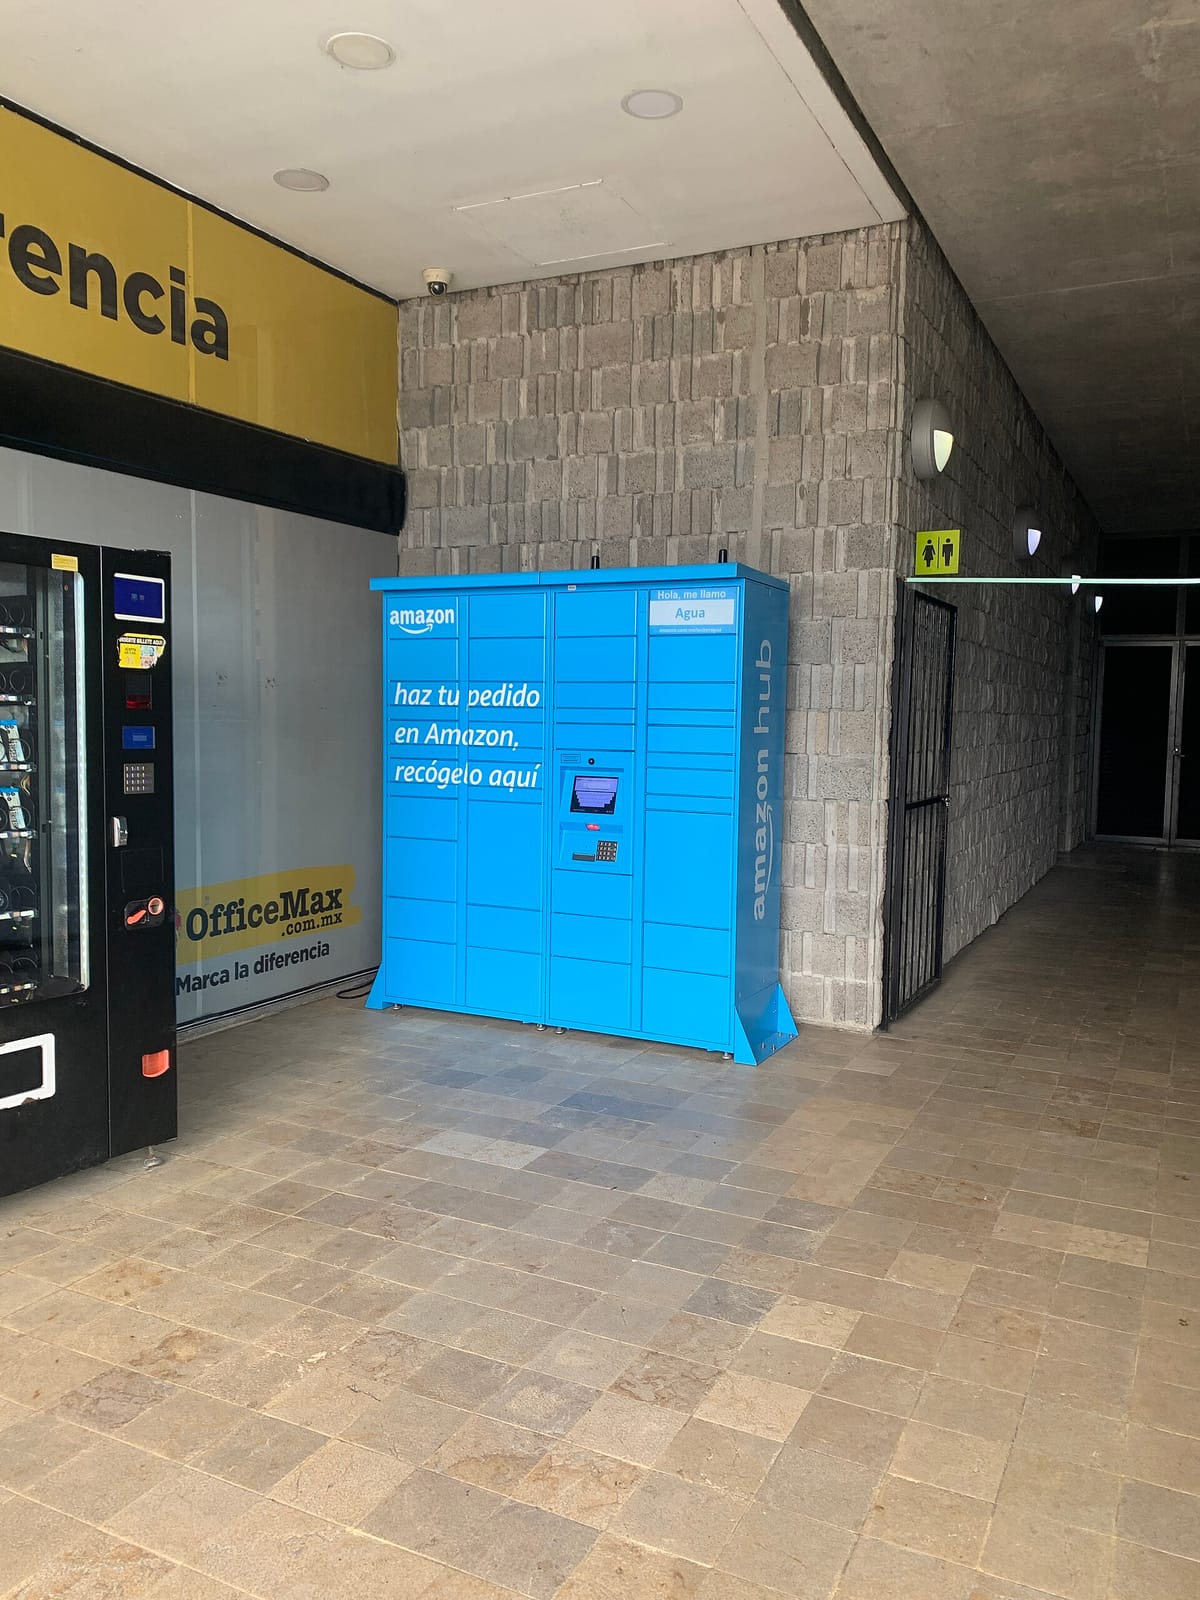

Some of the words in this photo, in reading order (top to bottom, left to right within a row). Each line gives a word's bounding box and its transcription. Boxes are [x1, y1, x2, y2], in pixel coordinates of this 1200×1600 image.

[0, 212, 229, 361] encia
[657, 590, 681, 600] Hola,
[683, 592, 698, 600] me
[700, 590, 727, 599] llamo
[389, 608, 455, 626] amazon
[675, 607, 705, 621] Agua
[394, 682, 432, 705] haz
[438, 685, 460, 706] tu
[466, 682, 540, 712] pedido
[753, 639, 772, 734] hub
[394, 726, 419, 744] en
[424, 722, 519, 751] Amazon,
[394, 760, 482, 789] recógelo
[489, 764, 541, 793] aquí
[753, 749, 769, 921] amazon
[186, 888, 343, 941] OfficeMax
[281, 911, 343, 937] .com.mx
[176, 968, 230, 995] Marca
[234, 961, 249, 980] la
[253, 941, 330, 975] diferencia
